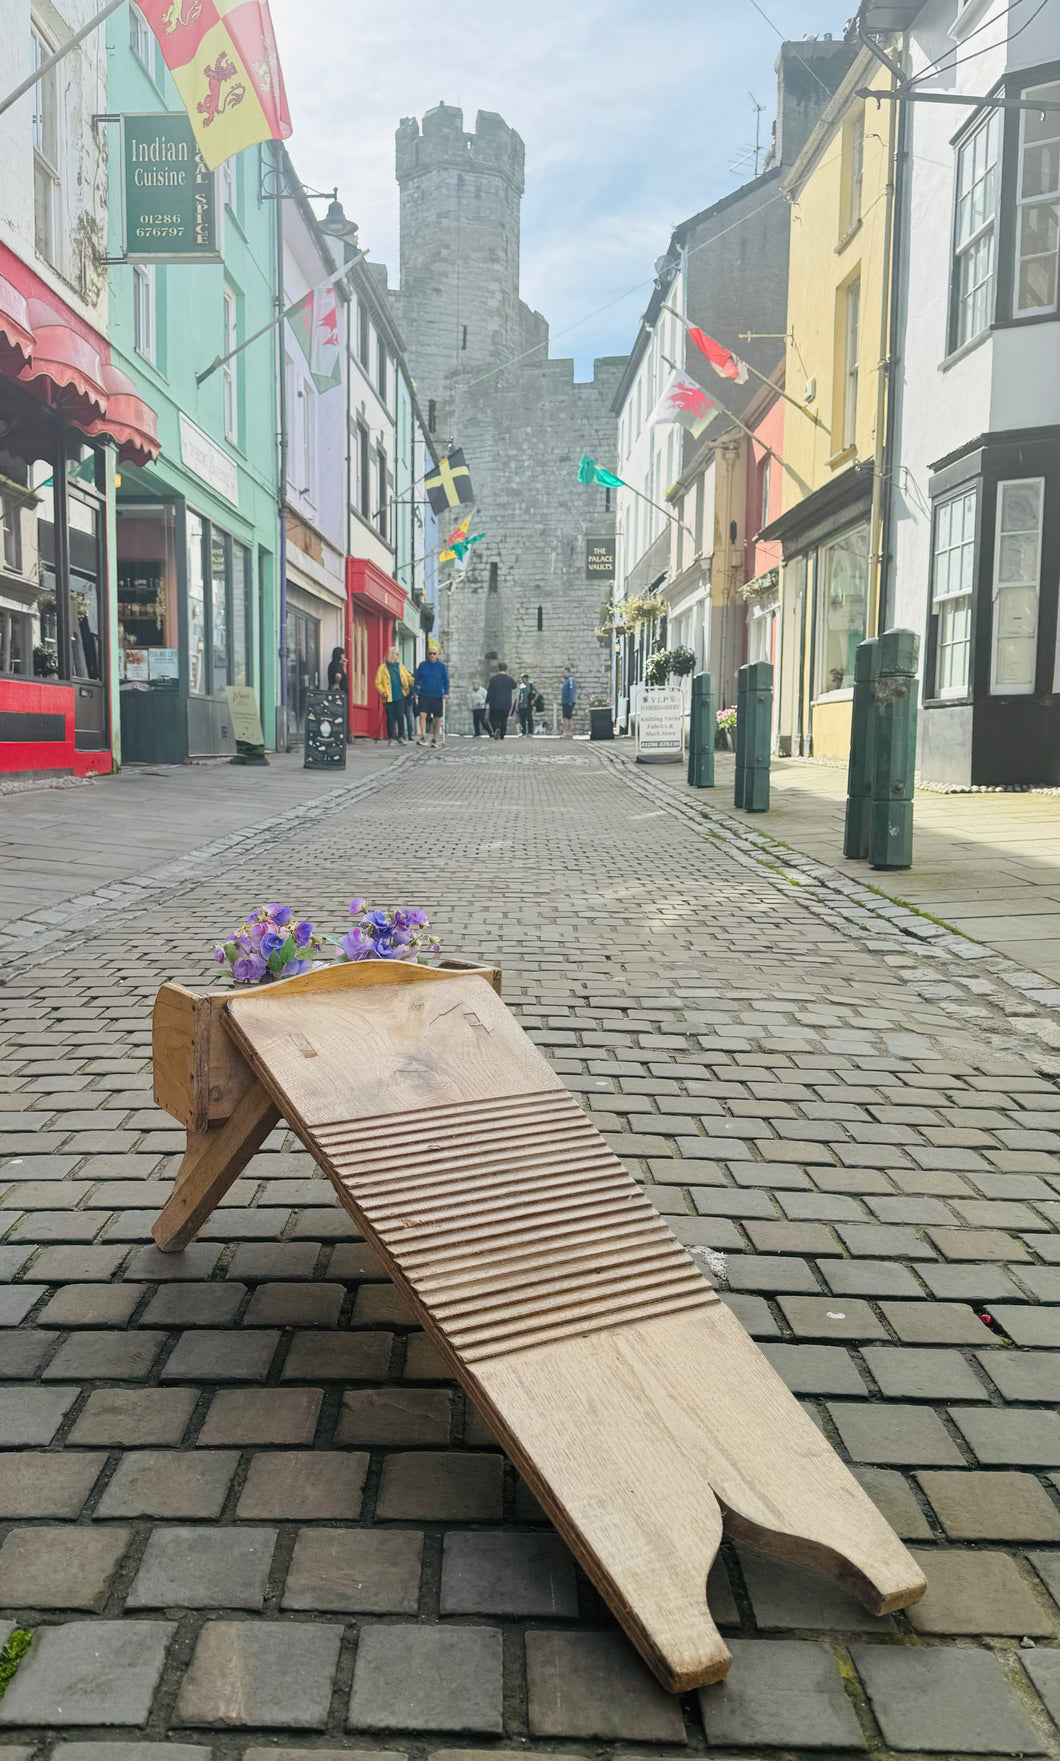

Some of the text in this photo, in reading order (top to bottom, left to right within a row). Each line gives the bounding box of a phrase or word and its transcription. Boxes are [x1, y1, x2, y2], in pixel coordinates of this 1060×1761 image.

[131, 137, 188, 162] Indian
[134, 166, 186, 187] Cuisine
[140, 214, 181, 224] 01286
[194, 193, 209, 244] SPICE
[136, 227, 185, 237] 676797
[588, 555, 613, 563] PALACE
